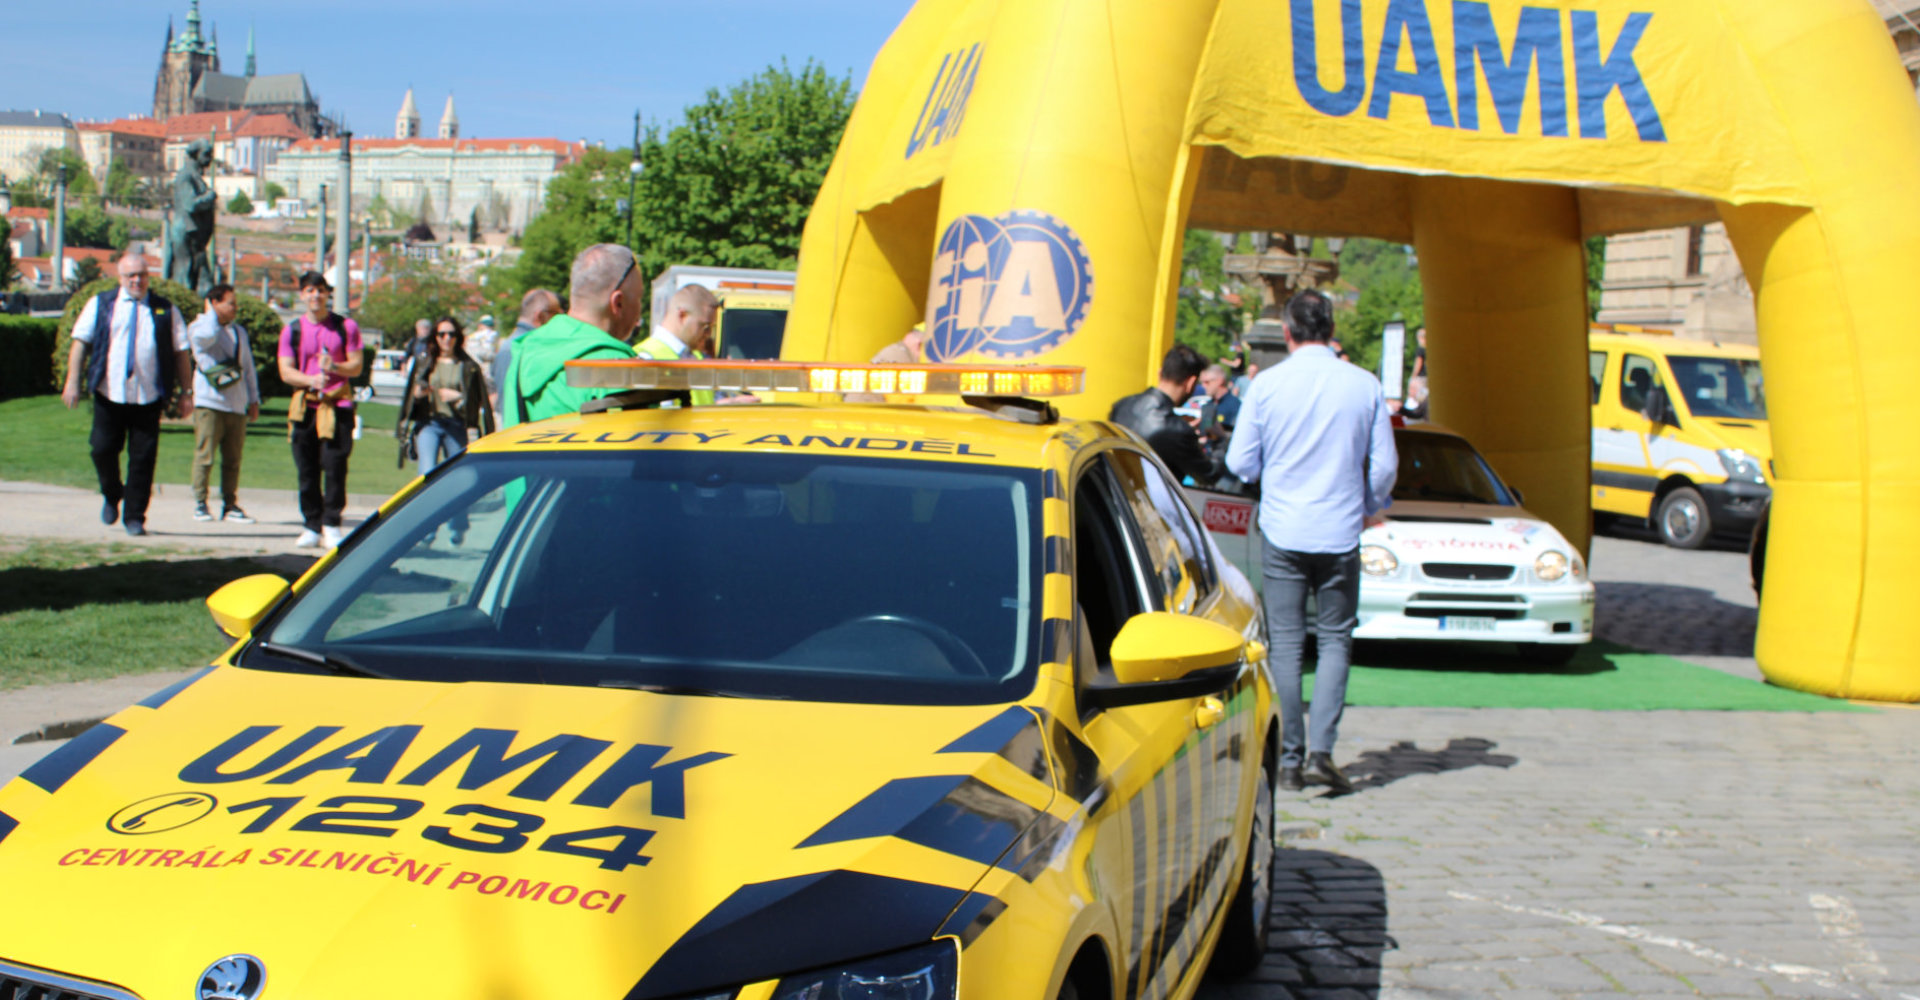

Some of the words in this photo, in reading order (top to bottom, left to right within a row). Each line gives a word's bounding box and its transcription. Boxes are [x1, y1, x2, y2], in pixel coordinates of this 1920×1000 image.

[1289, 0, 1667, 142] UAMK
[516, 429, 735, 444] ŽLUTÝ
[742, 434, 996, 458] ANDĚL
[1438, 537, 1522, 551] TOYOTA
[178, 724, 736, 820] UAMK
[226, 795, 658, 872] 1234
[58, 846, 253, 868] CENTRÁLA
[259, 847, 452, 886] SILNIČNÍ
[447, 871, 627, 914] POMOCI
